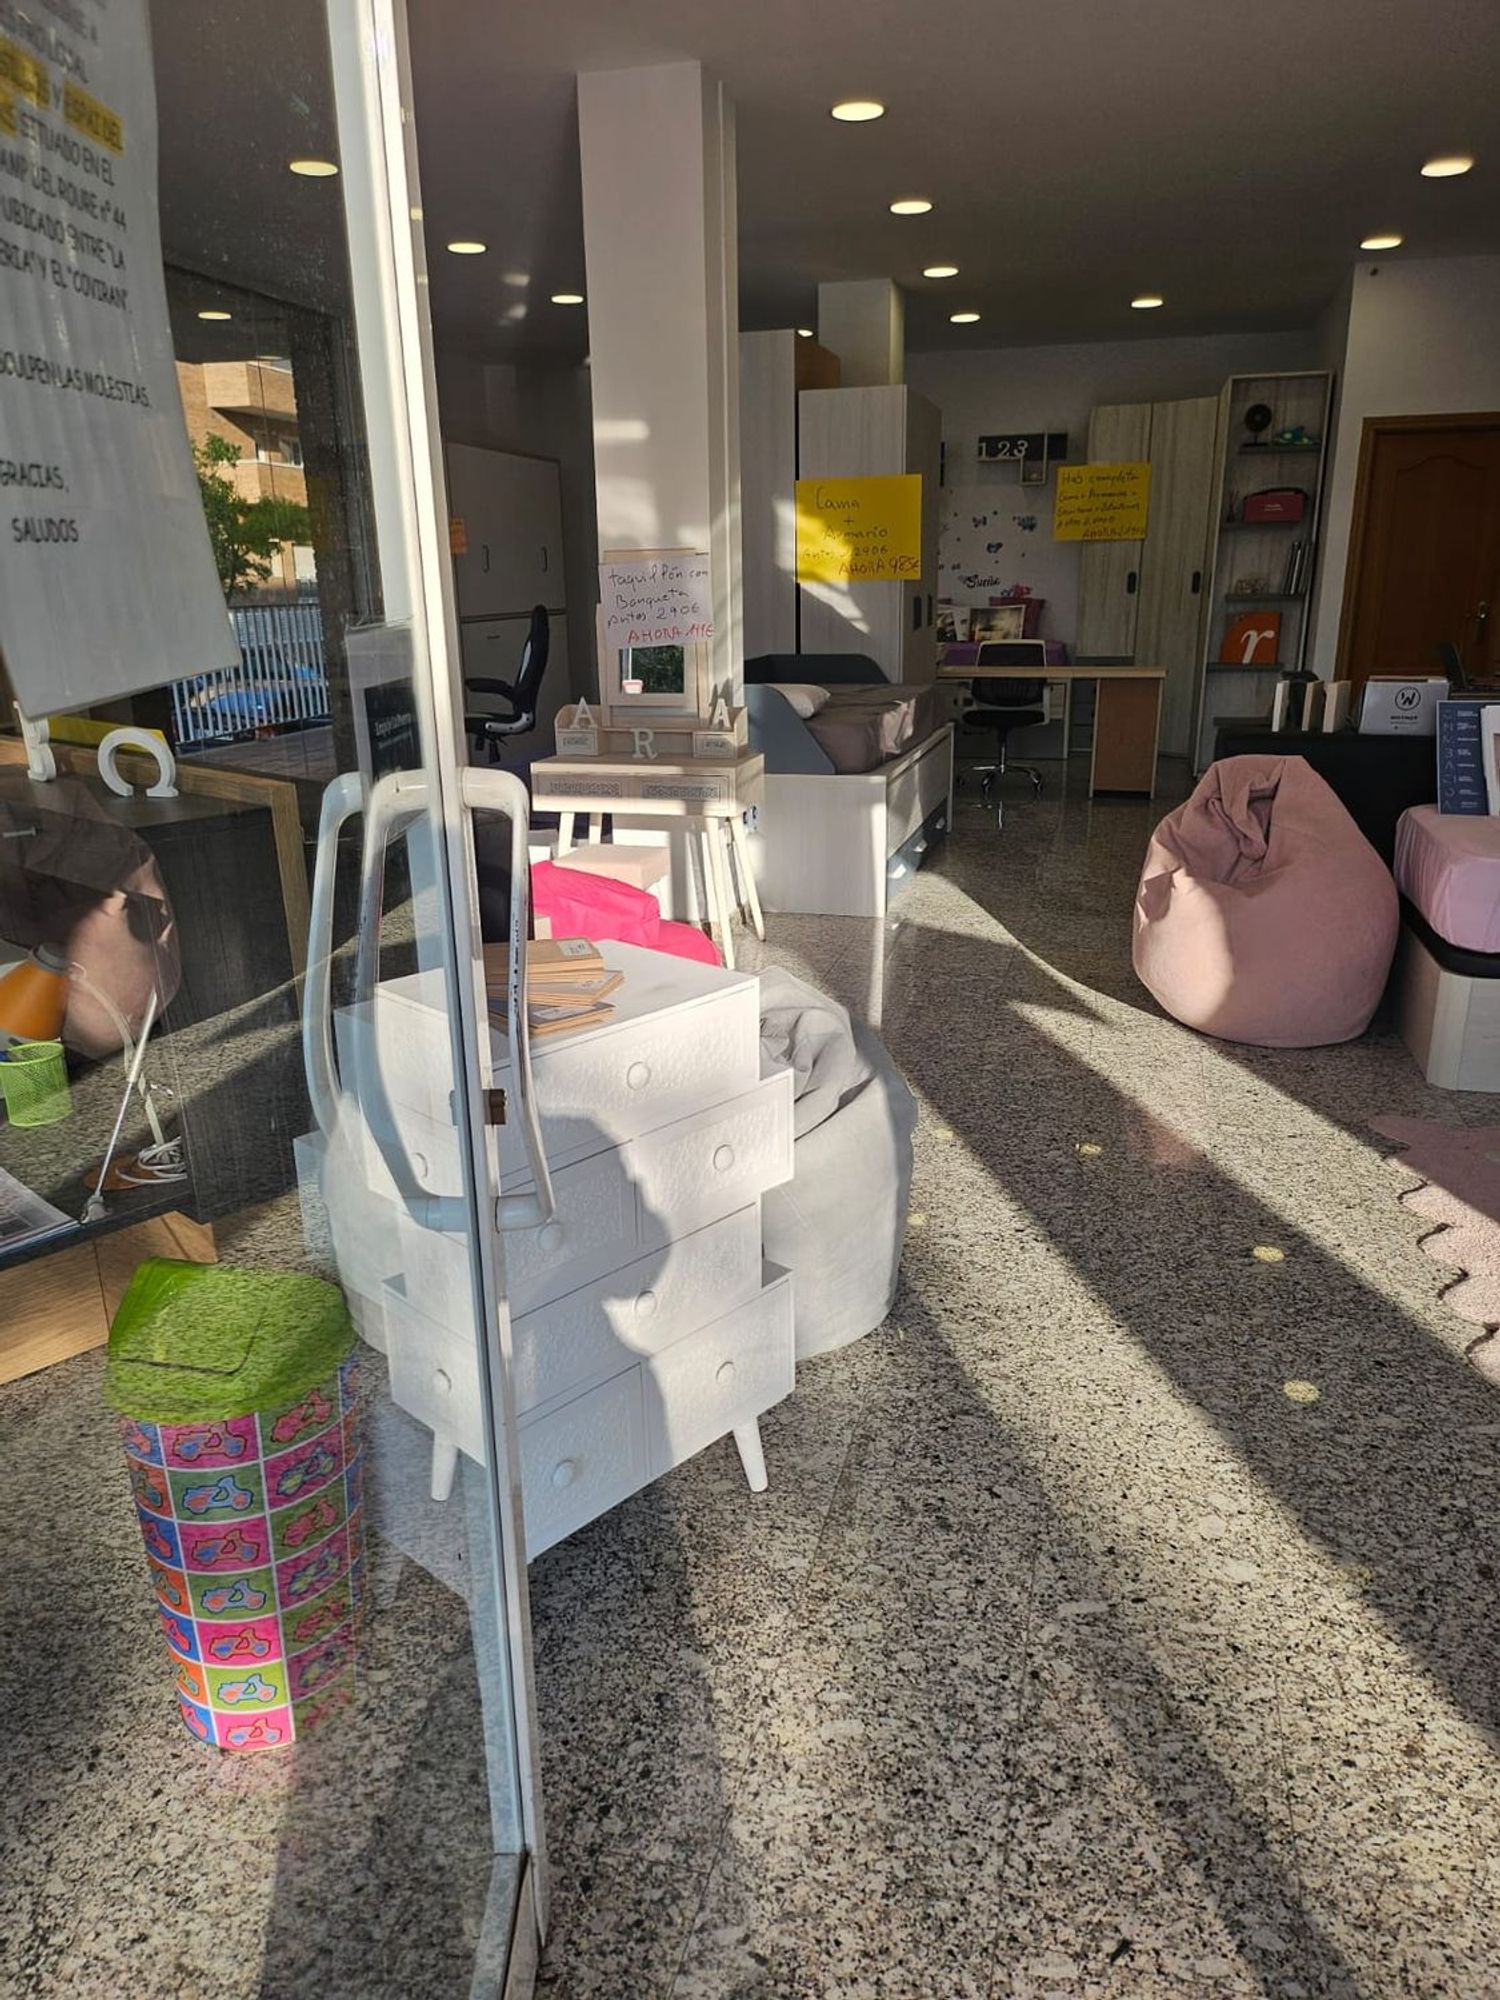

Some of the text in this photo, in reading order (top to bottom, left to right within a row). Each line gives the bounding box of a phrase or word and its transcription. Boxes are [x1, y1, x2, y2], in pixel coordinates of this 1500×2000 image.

[102, 158, 115, 186] EL
[0, 149, 27, 181] AMP
[113, 207, 127, 233] 44
[51, 259, 67, 289] EL
[11, 517, 79, 544] SALUDOS
[627, 624, 682, 644] AHORA
[569, 696, 731, 759] A R A
